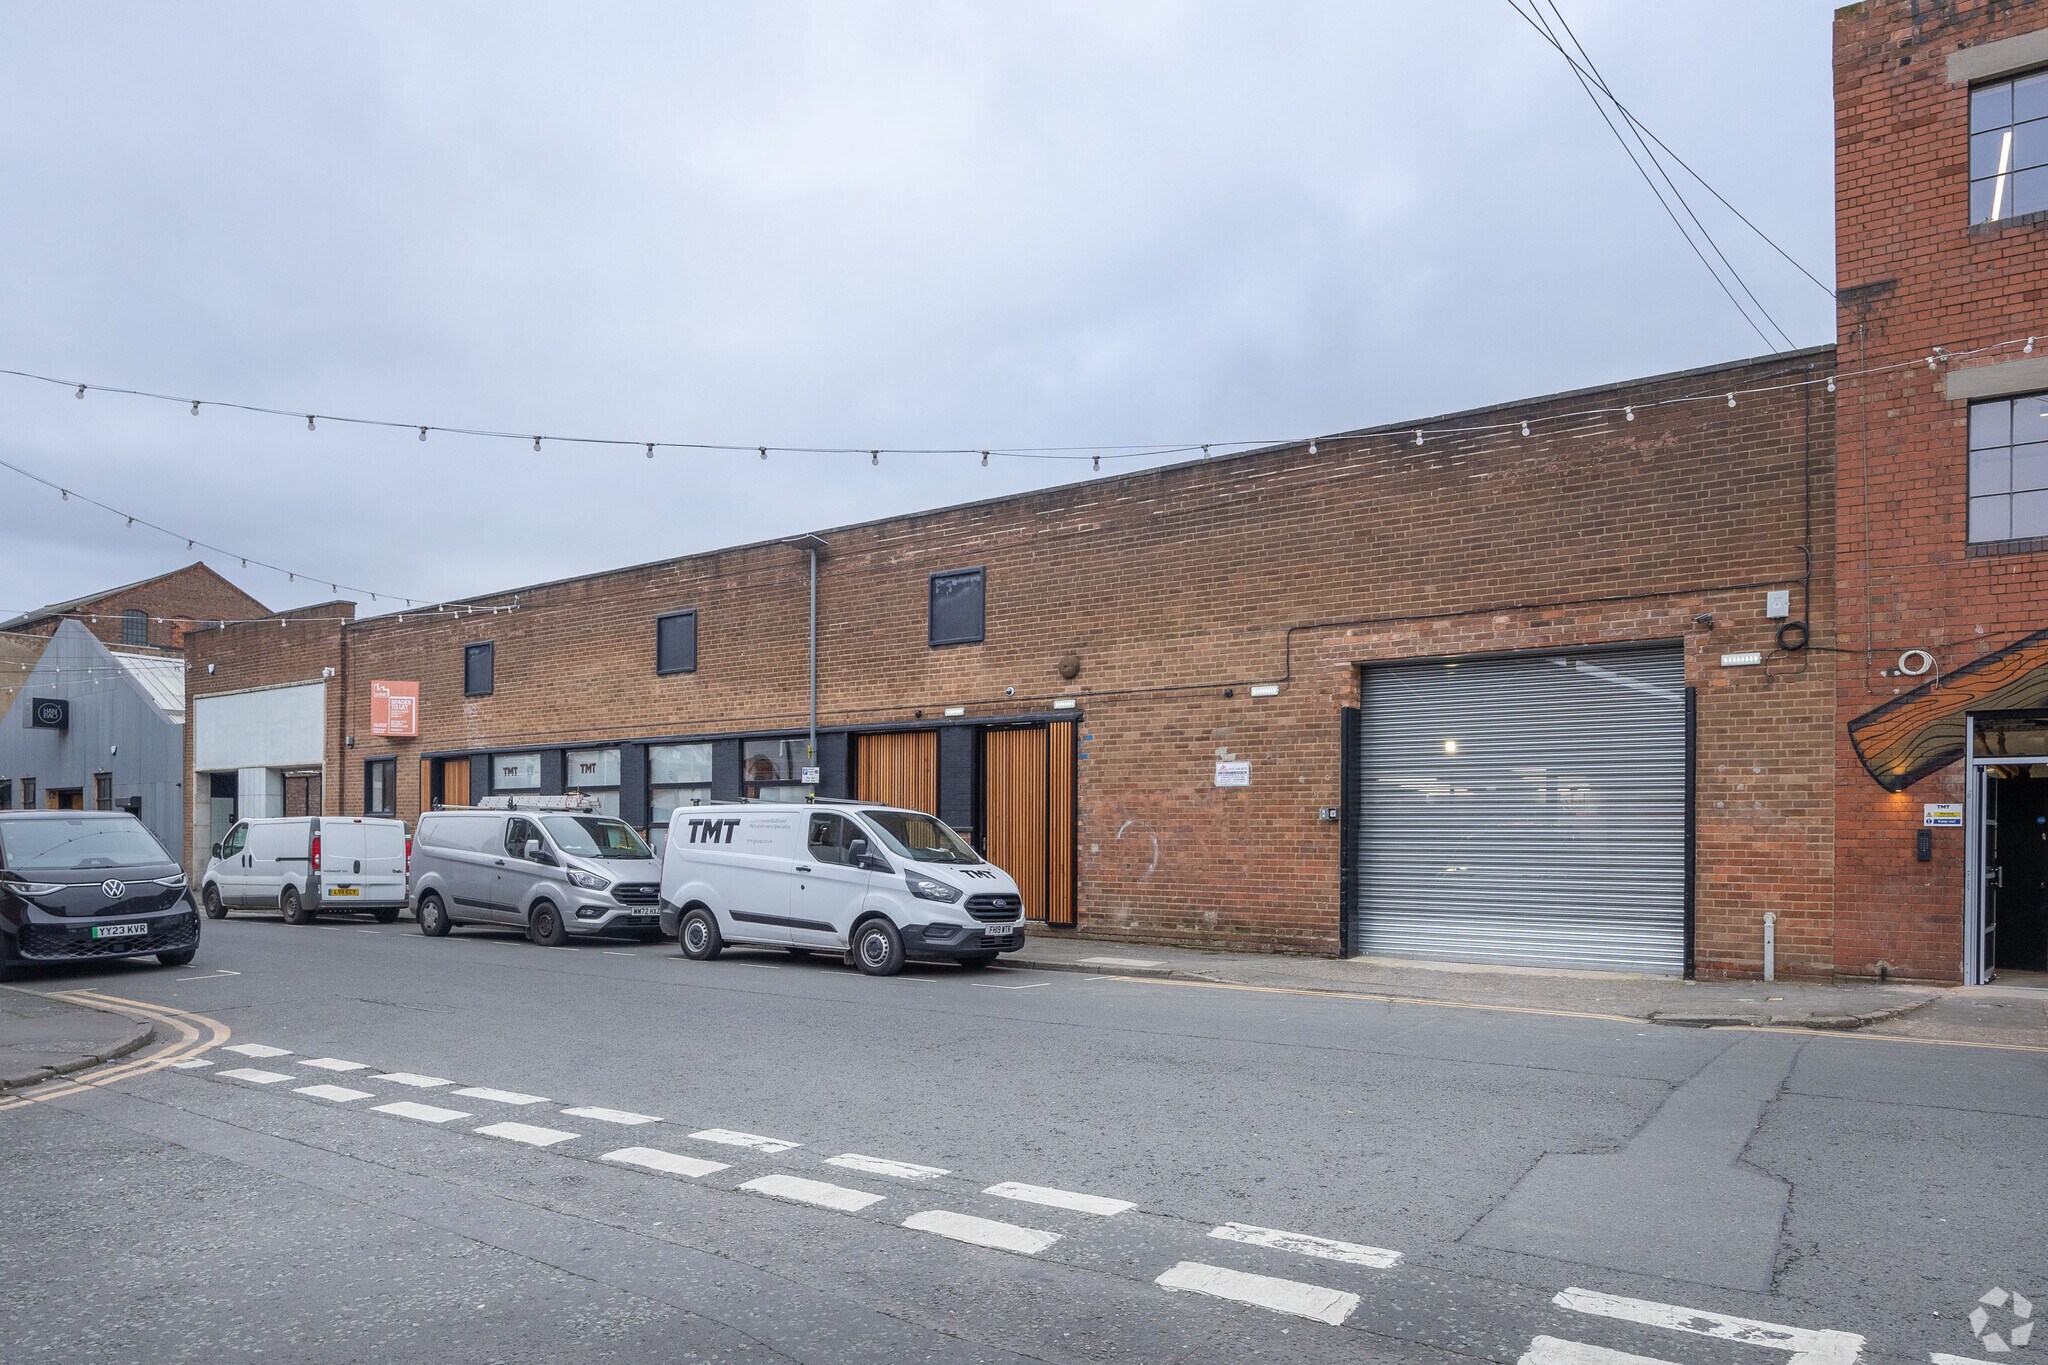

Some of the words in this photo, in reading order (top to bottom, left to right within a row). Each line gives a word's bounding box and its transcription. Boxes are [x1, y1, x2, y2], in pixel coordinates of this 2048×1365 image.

[503, 767, 518, 776] TMT
[580, 763, 596, 774] TMT
[688, 819, 741, 843] TMT
[959, 869, 997, 880] TMT
[99, 926, 125, 936] YY23
[127, 924, 146, 934] KVR
